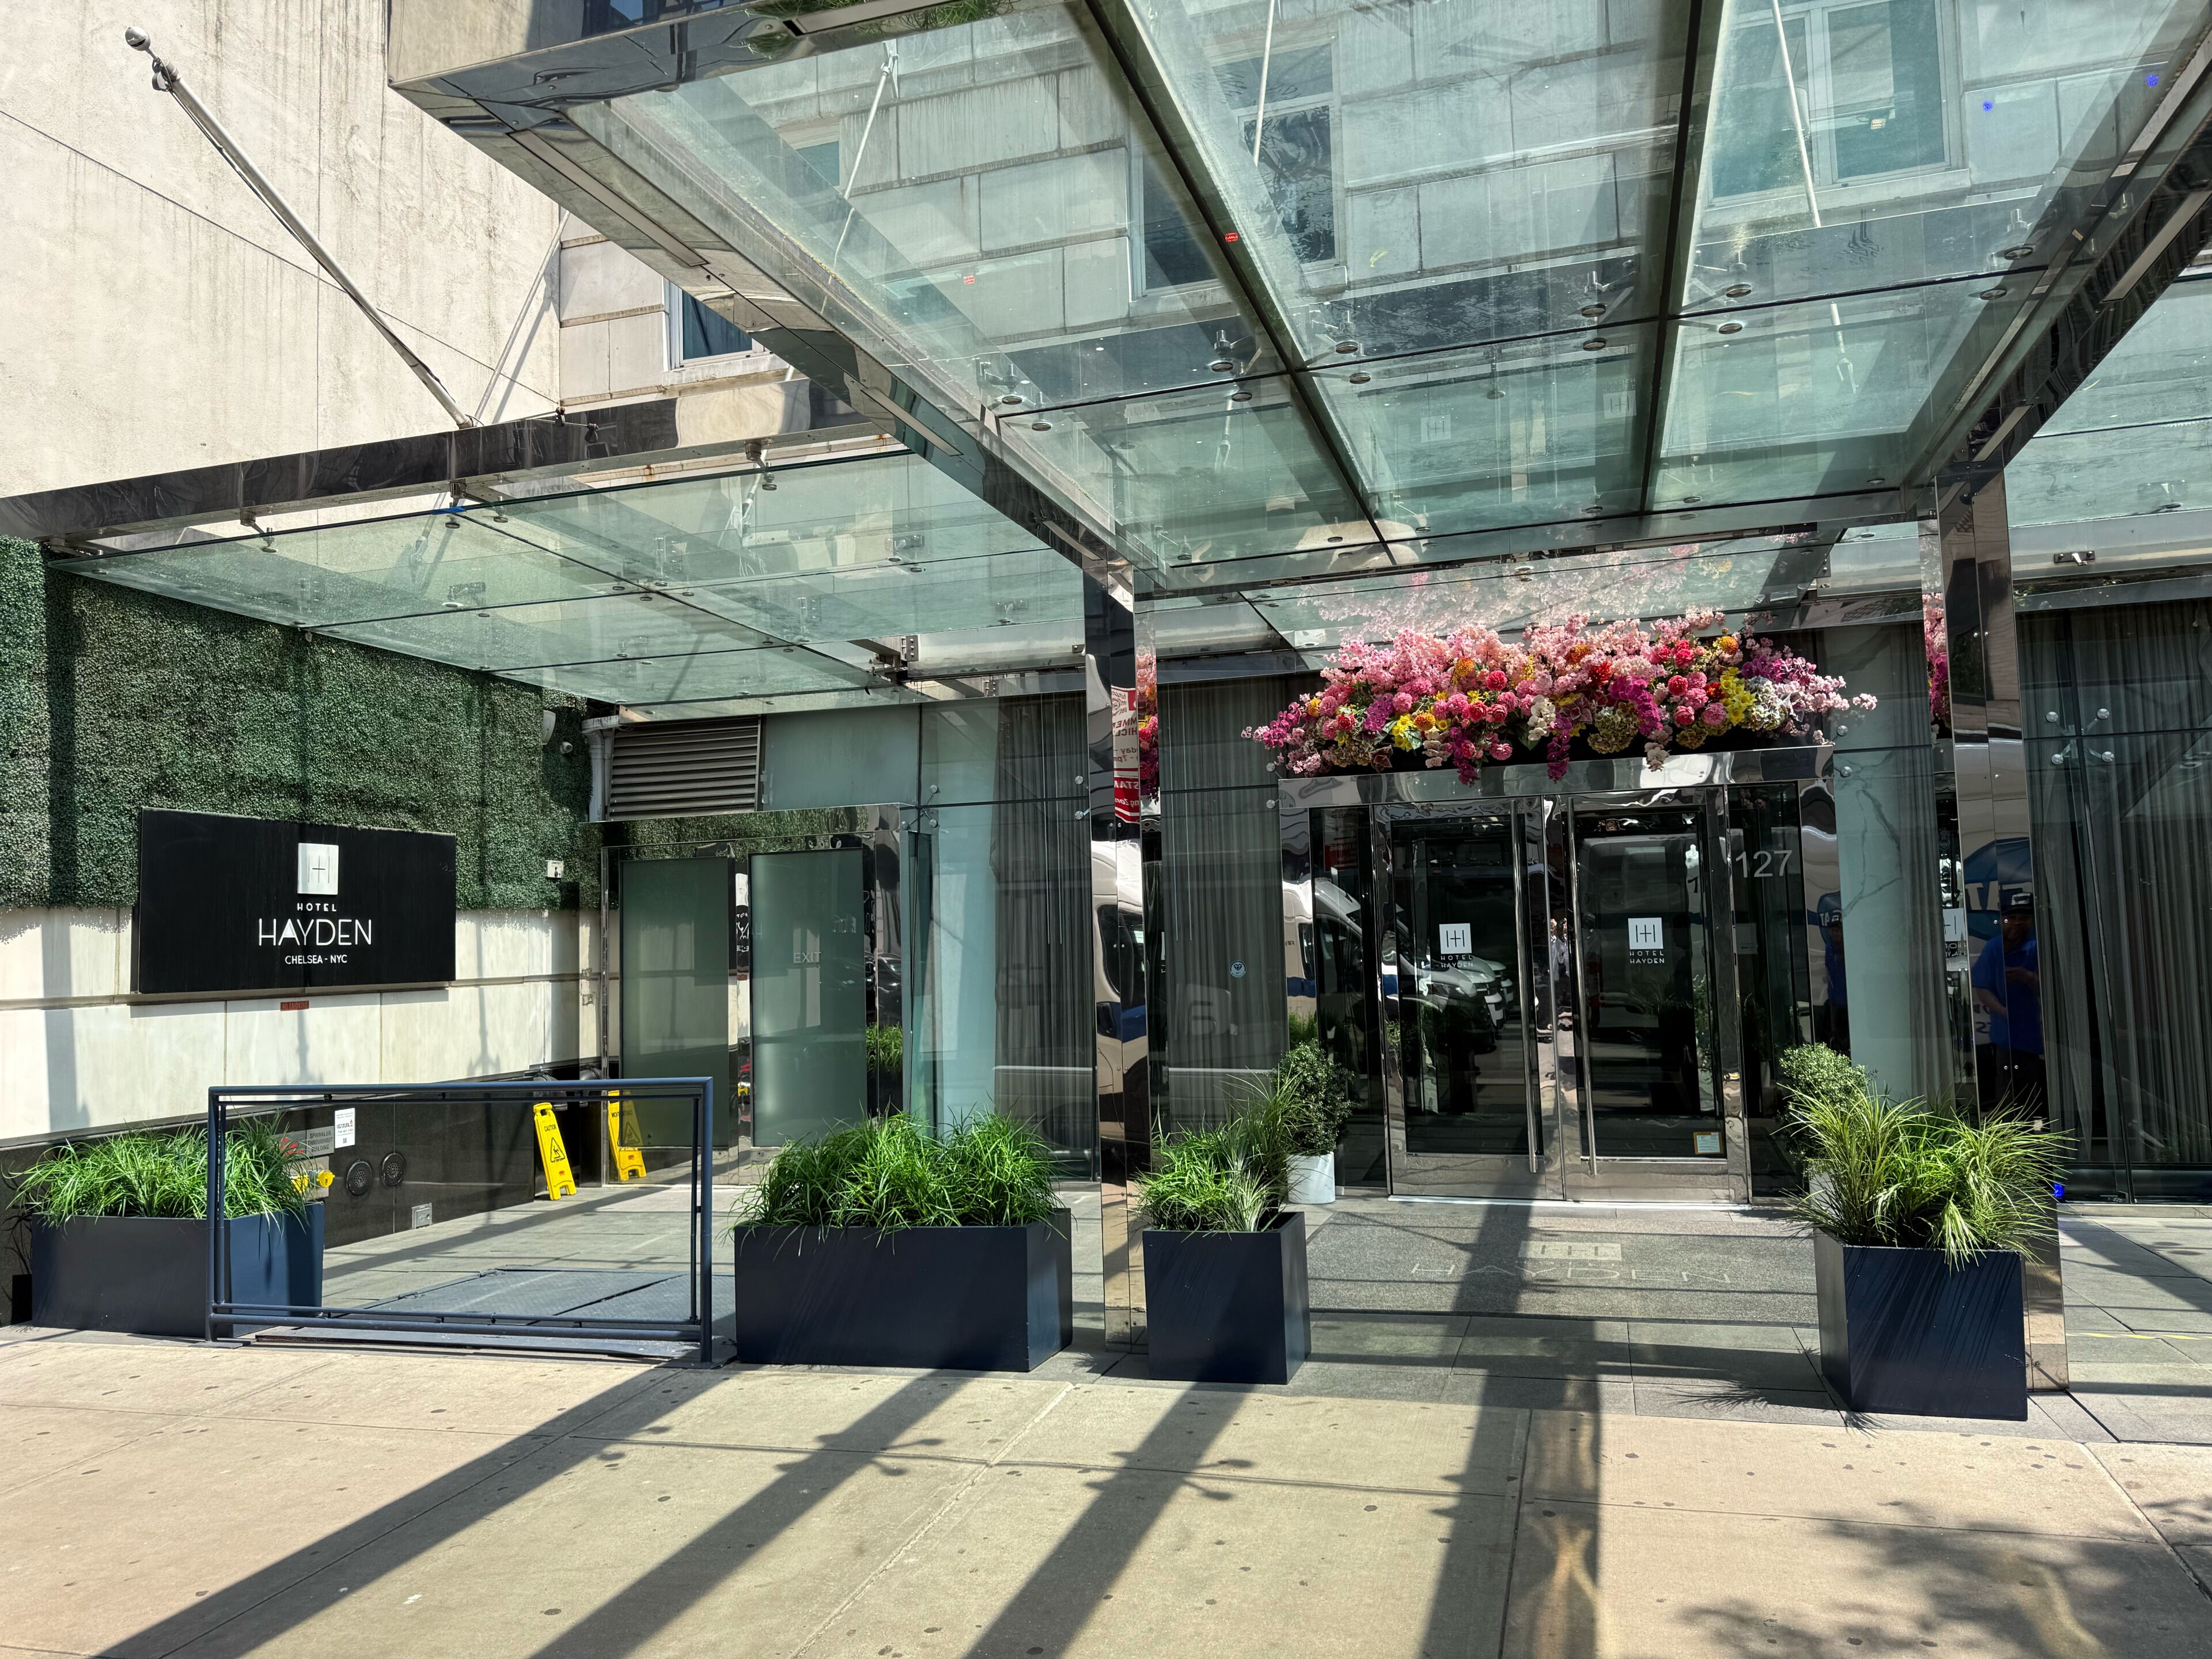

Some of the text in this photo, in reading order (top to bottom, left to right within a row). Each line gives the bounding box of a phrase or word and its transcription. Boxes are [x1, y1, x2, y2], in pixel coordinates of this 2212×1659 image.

[1735, 850, 1793, 878] 127
[297, 903, 337, 912] HOTEL
[259, 918, 372, 946] HAYDEN
[285, 955, 323, 964] CHELSEA
[330, 955, 347, 963] NYC
[793, 952, 821, 963] EXIT
[544, 1124, 557, 1132] CAUTION
[310, 1130, 331, 1139] SPRINKLER
[308, 1137, 333, 1146] THROUGHOUT
[1411, 1263, 1730, 1283] HAYDEN
